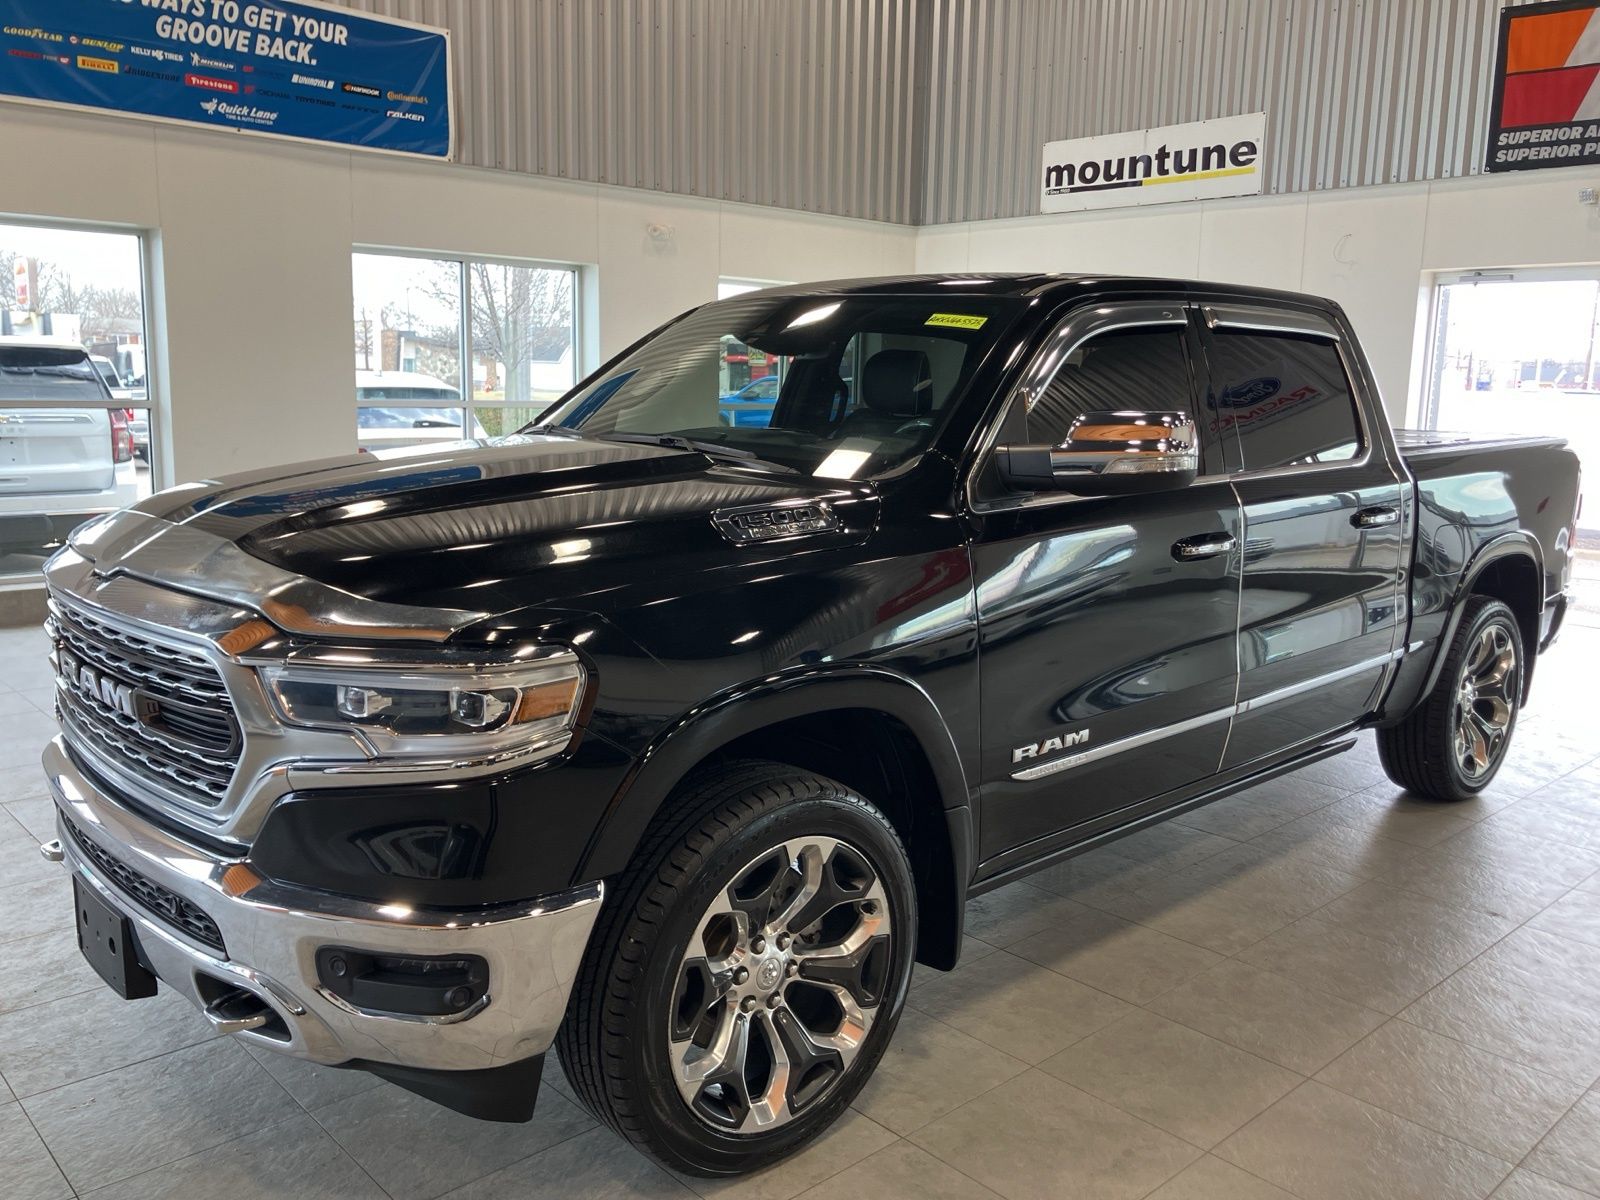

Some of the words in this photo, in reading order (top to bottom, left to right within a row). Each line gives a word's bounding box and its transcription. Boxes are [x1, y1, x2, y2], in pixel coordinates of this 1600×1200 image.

[211, 0, 239, 23] TO
[244, 5, 287, 32] GET
[292, 14, 348, 46] YOUR
[4, 26, 63, 42] GOODYEAR
[156, 15, 251, 53] GROOVE
[255, 34, 317, 66] BACK.
[82, 38, 125, 51] DUNLOP
[130, 46, 152, 56] KELLY
[200, 58, 234, 69] MICHELIN
[191, 77, 233, 91] Firestone
[218, 102, 249, 116] Quick
[250, 107, 278, 121] Lane
[1497, 126, 1584, 146] SUPERIOR
[1584, 124, 1600, 138] A
[1495, 143, 1582, 163] SUPERIOR
[1045, 140, 1257, 188] mountune
[736, 508, 818, 529] 1500
[60, 650, 135, 722] RAM
[1011, 728, 1089, 764] RAM
